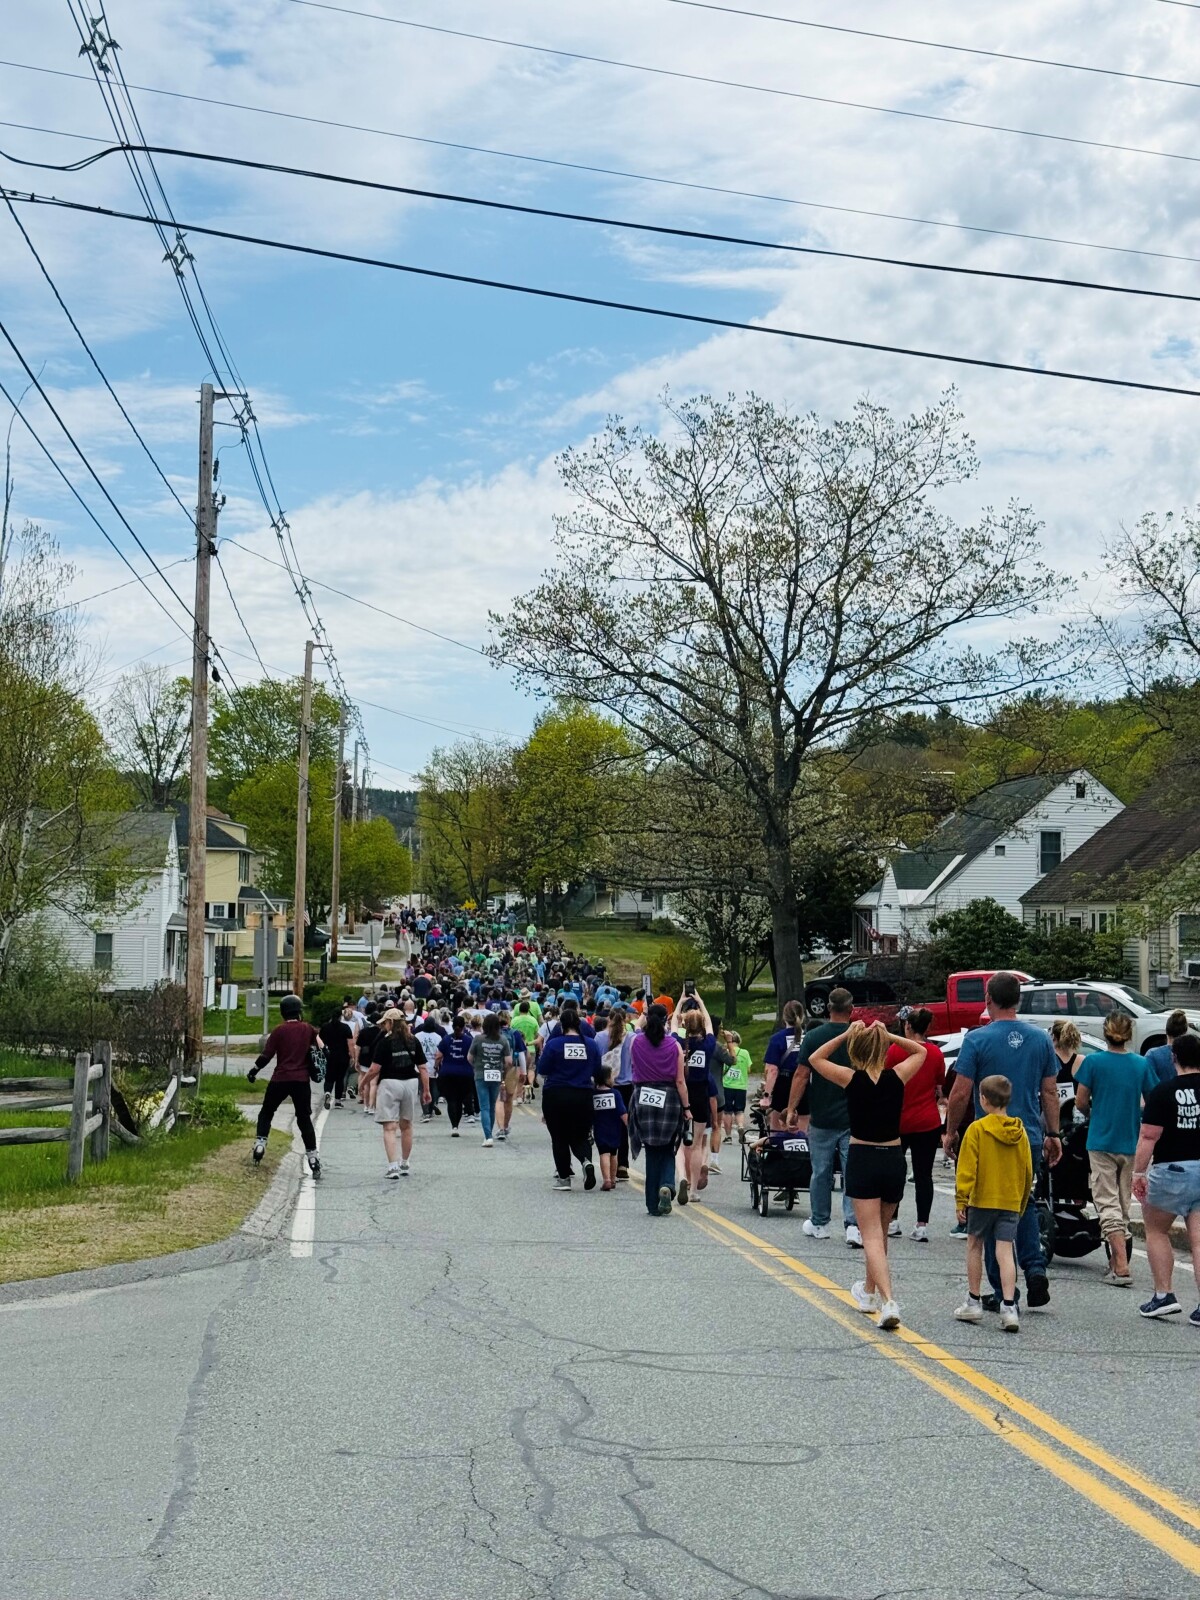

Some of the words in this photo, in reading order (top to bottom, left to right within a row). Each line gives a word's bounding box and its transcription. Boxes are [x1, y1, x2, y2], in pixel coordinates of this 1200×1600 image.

[567, 1048, 584, 1057] 252
[642, 1093, 662, 1105] 262
[1175, 1088, 1197, 1105] ON
[595, 1098, 612, 1108] 261
[1176, 1116, 1197, 1129] LAST
